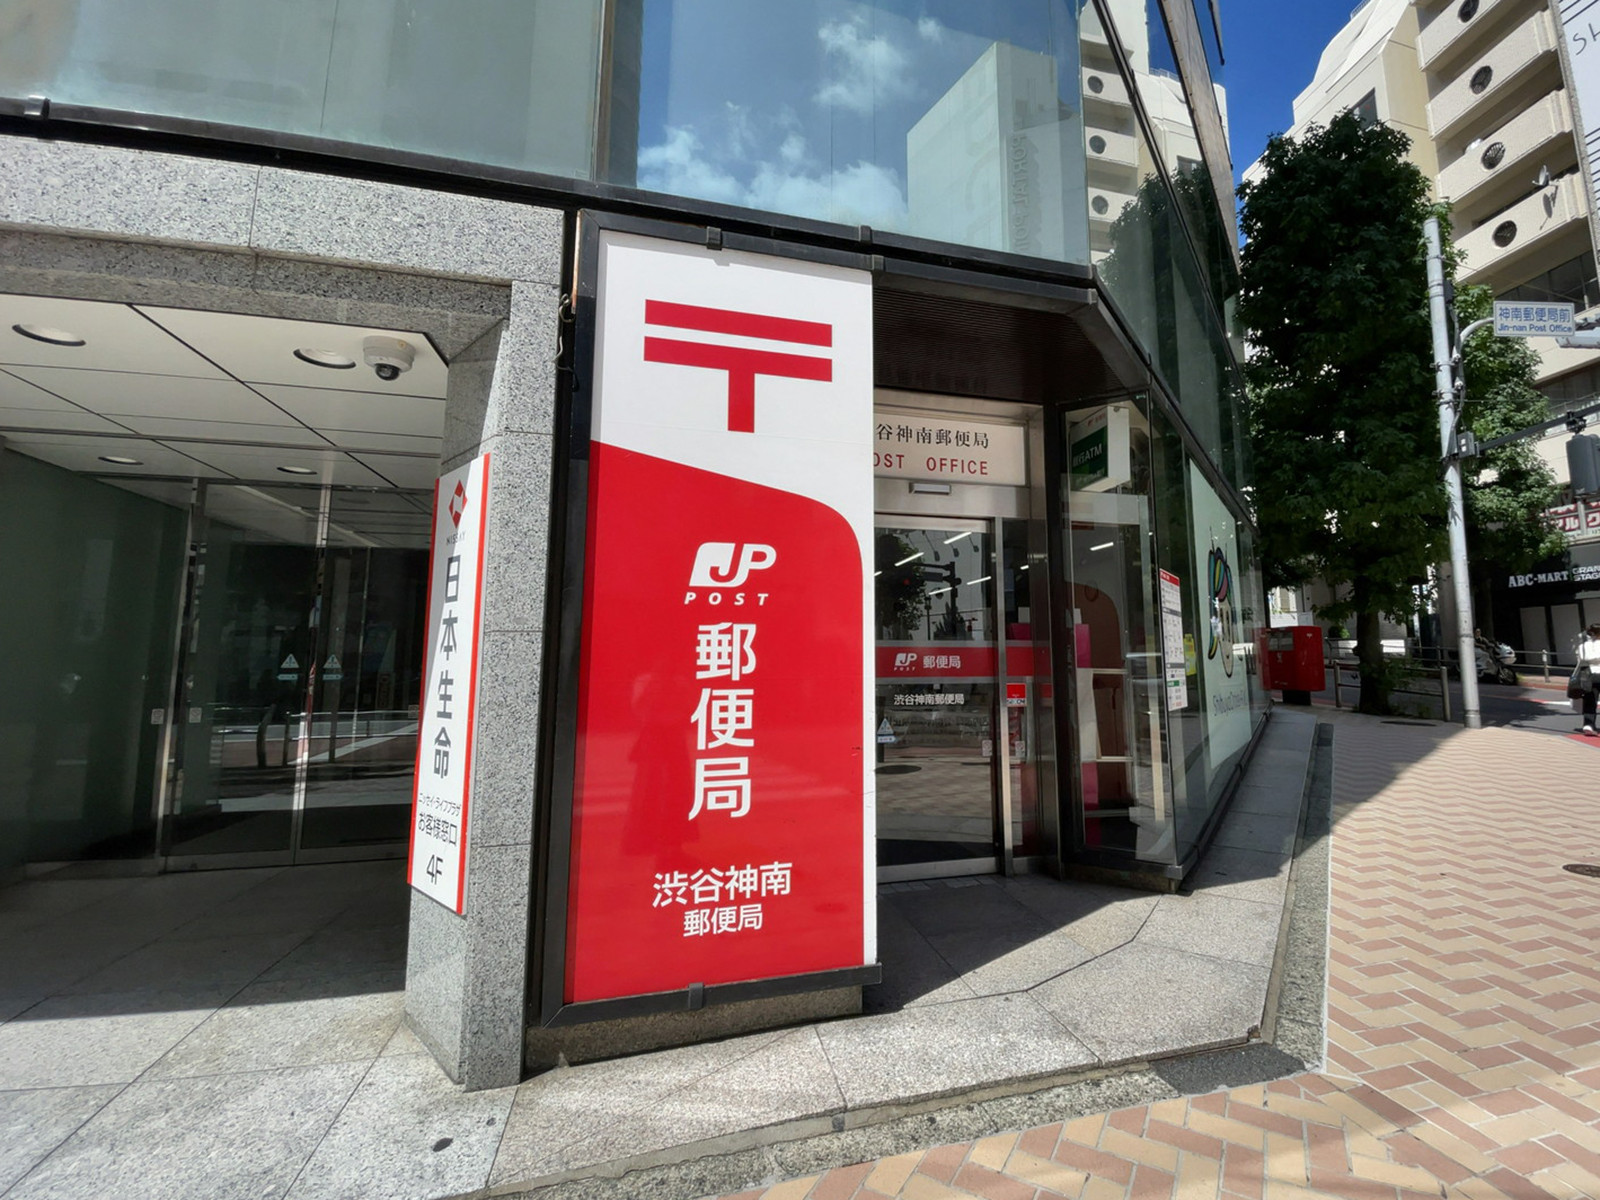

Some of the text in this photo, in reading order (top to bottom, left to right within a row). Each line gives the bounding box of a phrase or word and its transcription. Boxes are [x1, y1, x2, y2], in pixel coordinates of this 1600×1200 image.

[1499, 307, 1570, 323] 神南郵便局前
[1498, 323, 1572, 333] Jin-nan Post Office
[876, 423, 989, 449] 谷神南郵便局
[926, 457, 988, 475] OFFICE
[1508, 570, 1569, 588] ABC-MART
[1573, 572, 1600, 582] STAG
[684, 592, 769, 606] POST
[432, 556, 461, 780] 日本生命
[923, 655, 961, 669] 郵便局
[893, 693, 965, 706] 渋谷神南郵便局
[688, 622, 757, 821] 郵便局
[418, 812, 458, 847] お客様窓口
[426, 854, 444, 885] 4F
[652, 861, 793, 908] 渋谷神南
[683, 903, 763, 937] 郵便局
